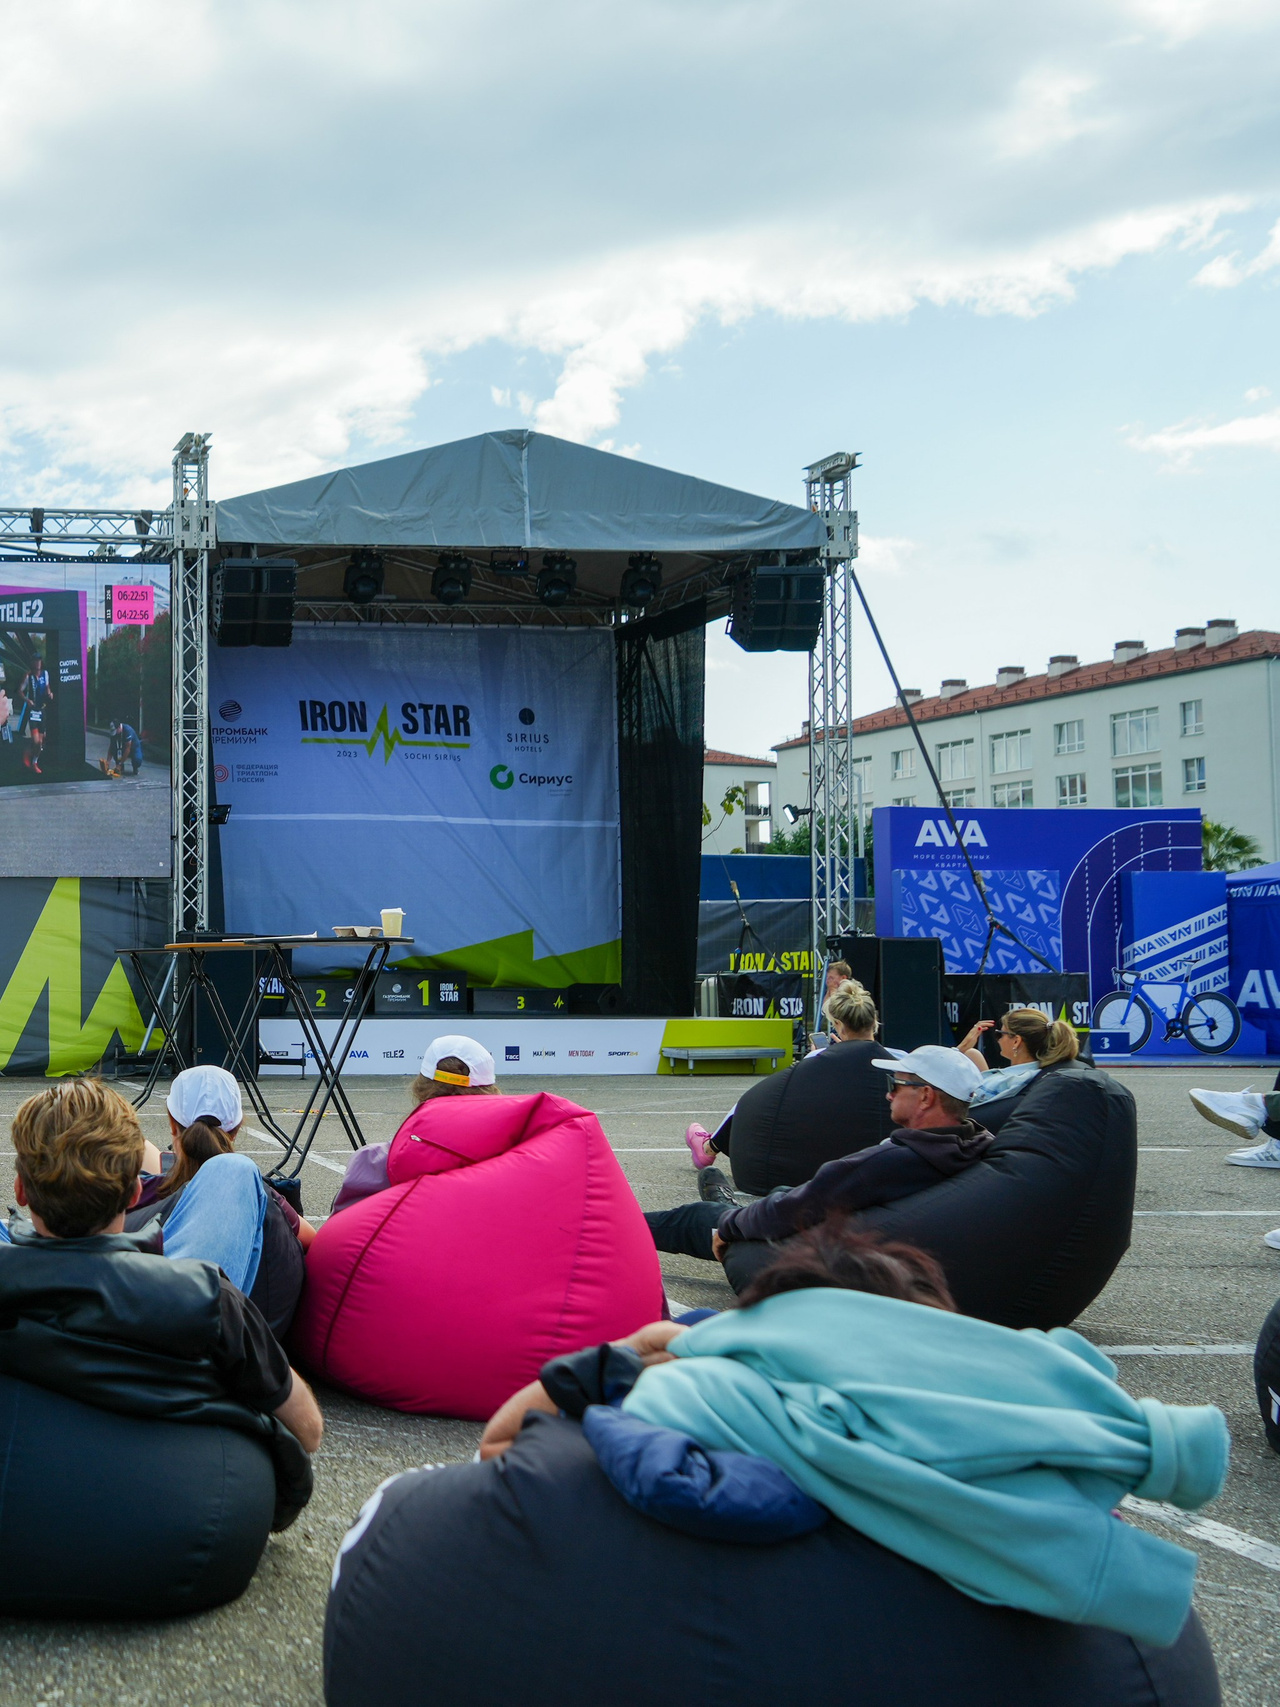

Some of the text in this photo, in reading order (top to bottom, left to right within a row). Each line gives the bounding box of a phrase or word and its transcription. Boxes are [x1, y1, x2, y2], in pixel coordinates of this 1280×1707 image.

[117, 590, 148, 601] 06:22:51
[0, 599, 44, 624] TELE2
[116, 609, 149, 620] 04:22:56
[299, 699, 470, 737] IRON STAR
[506, 732, 550, 744] SIRIUS
[336, 750, 358, 758] 2023
[514, 745, 542, 753] HOTELS
[404, 752, 461, 762] SOCHI SIRIUS
[236, 764, 279, 772] ФЕДЕРАЦИЯ
[519, 773, 573, 787] Сириус
[915, 820, 988, 847] AVA
[315, 989, 326, 1007] 2
[417, 980, 429, 1006] 1
[440, 991, 459, 1001] STAR
[516, 996, 525, 1010] 3
[1100, 1037, 1110, 1049] 3
[349, 1050, 369, 1058] AVA
[382, 1049, 405, 1059] TELE2
